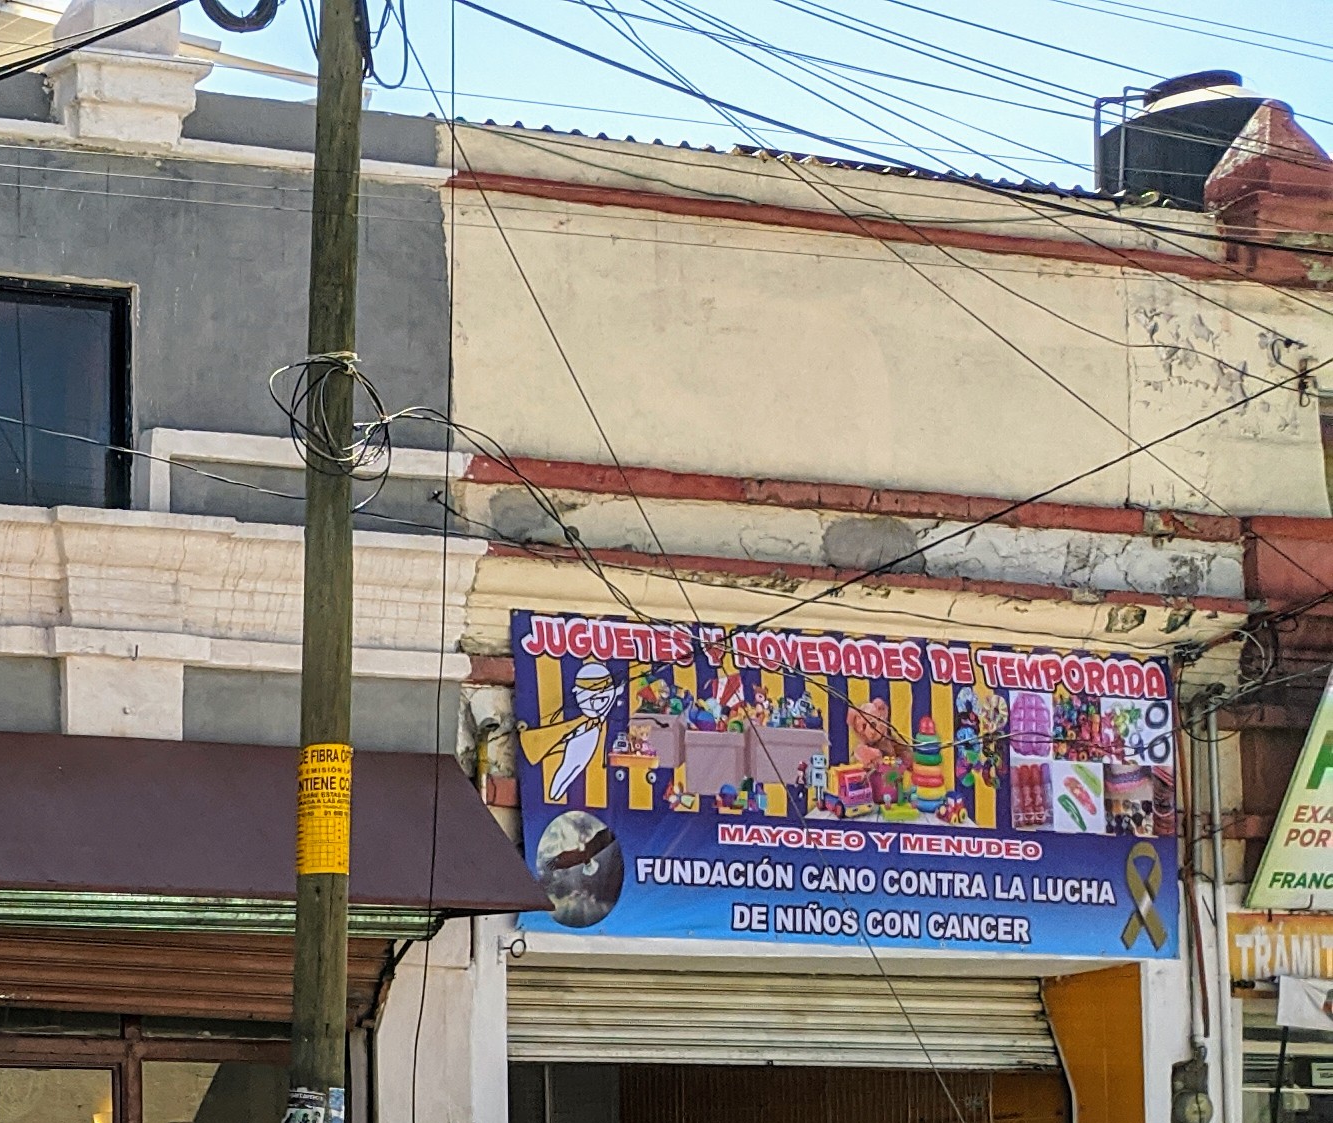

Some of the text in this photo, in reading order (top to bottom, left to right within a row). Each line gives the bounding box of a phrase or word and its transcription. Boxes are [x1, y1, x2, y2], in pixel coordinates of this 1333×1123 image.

[521, 616, 694, 664] JUGUETES
[732, 632, 923, 682] NOVEDADES
[927, 643, 974, 684] DE
[977, 650, 1167, 699] TEMPORADA
[310, 749, 339, 764] FIBRA
[718, 823, 1043, 861] MAYOREO Y MENUDEO
[1283, 828, 1332, 848] POR
[636, 857, 1115, 904] FUNDACIÓN CANO CONTRA LA LUCHA
[733, 903, 1030, 942] DE NIÑOS CON CANCER
[1234, 921, 1333, 980] TRÁMIT
